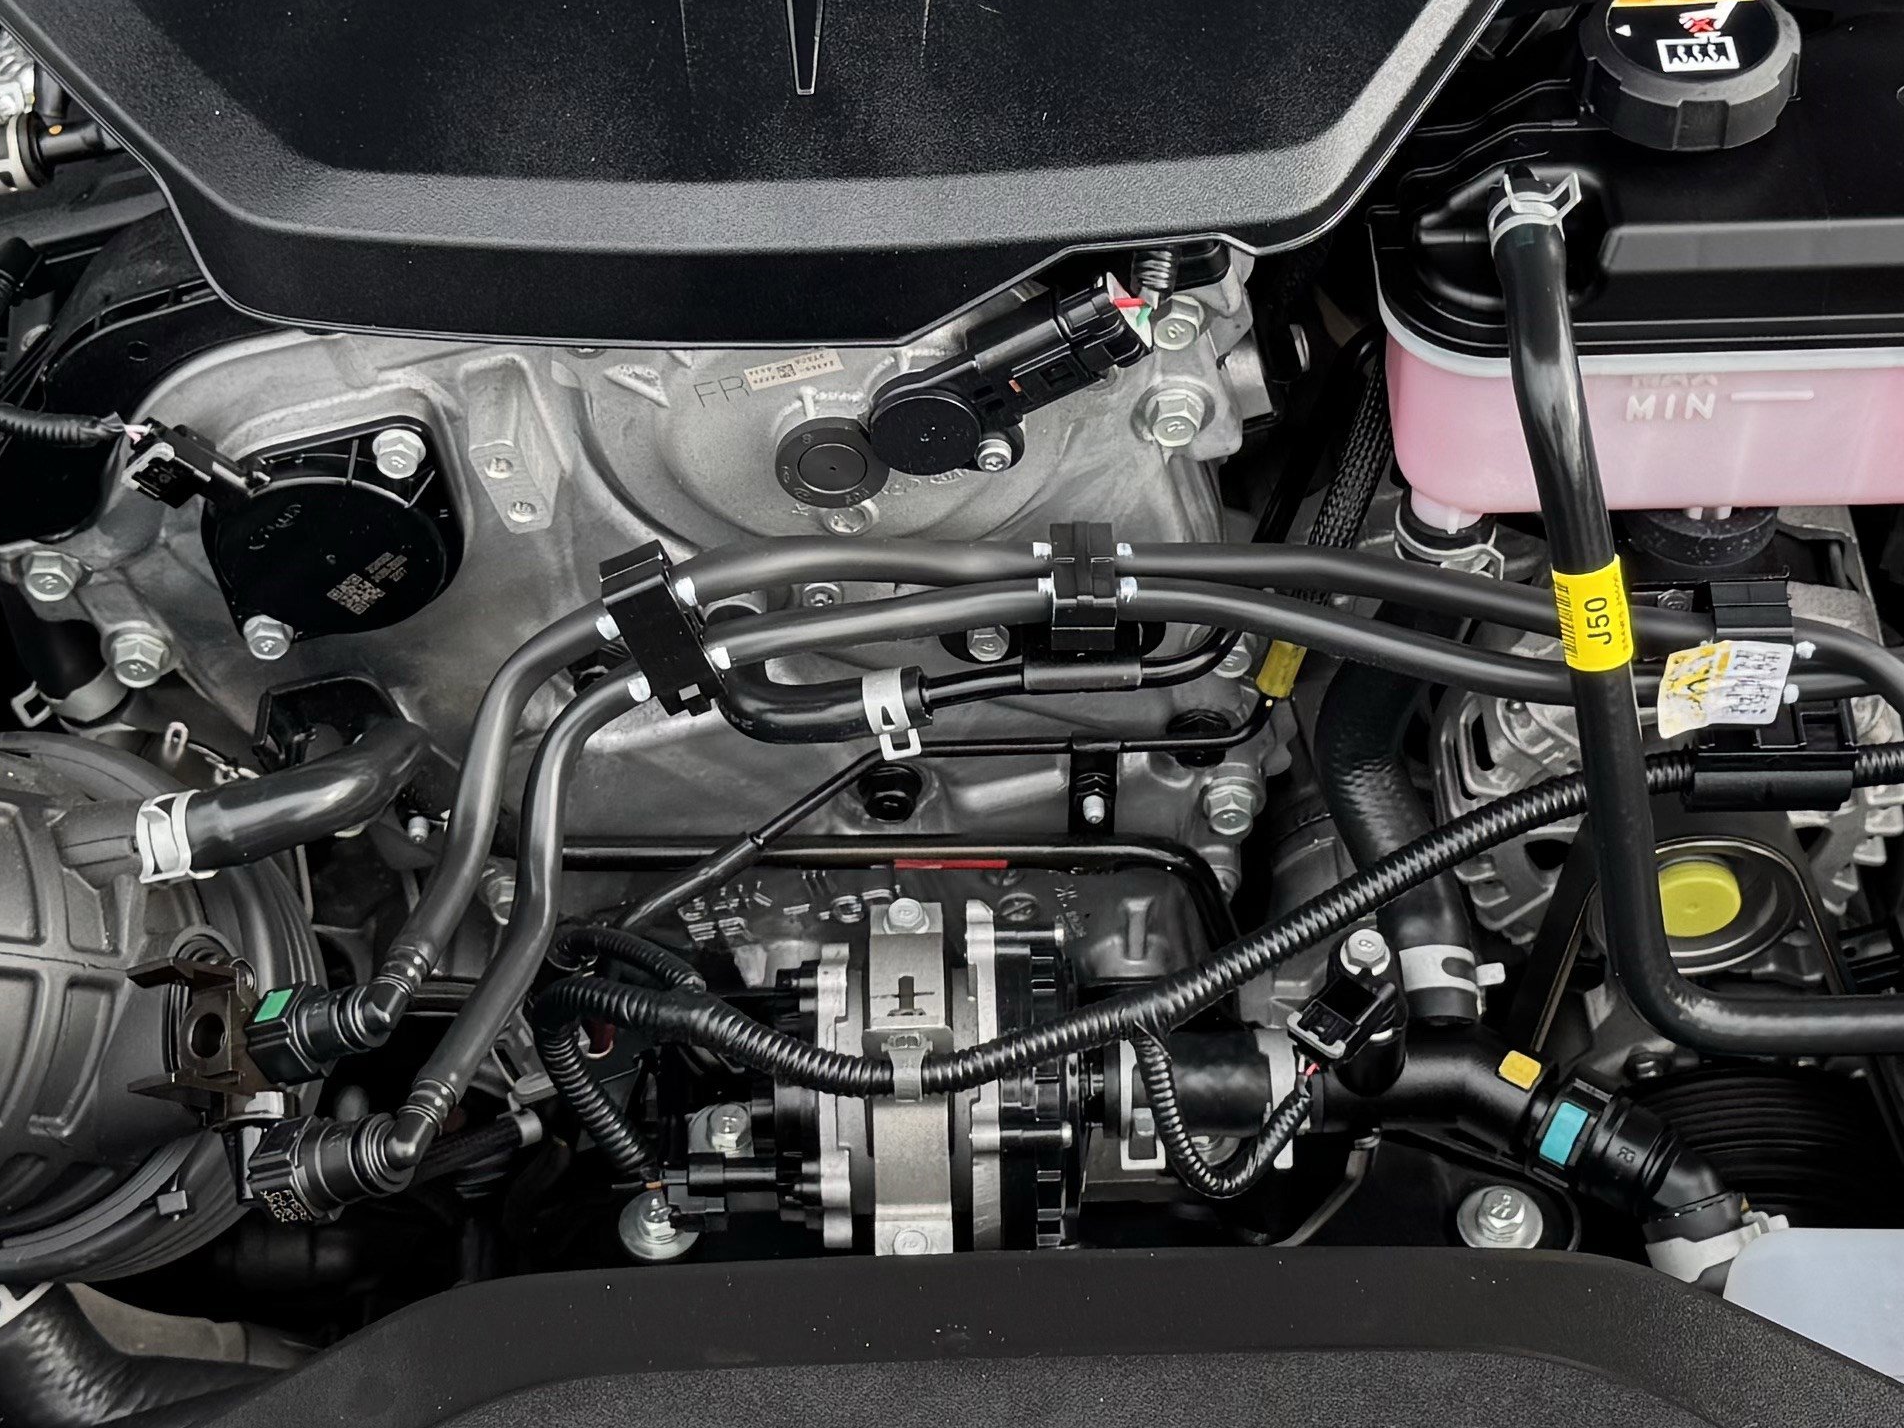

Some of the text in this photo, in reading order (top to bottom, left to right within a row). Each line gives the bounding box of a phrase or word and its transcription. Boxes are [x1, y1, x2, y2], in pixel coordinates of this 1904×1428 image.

[693, 376, 750, 408] FR
[1625, 392, 1716, 423] MIN
[1583, 594, 1614, 647] J50
